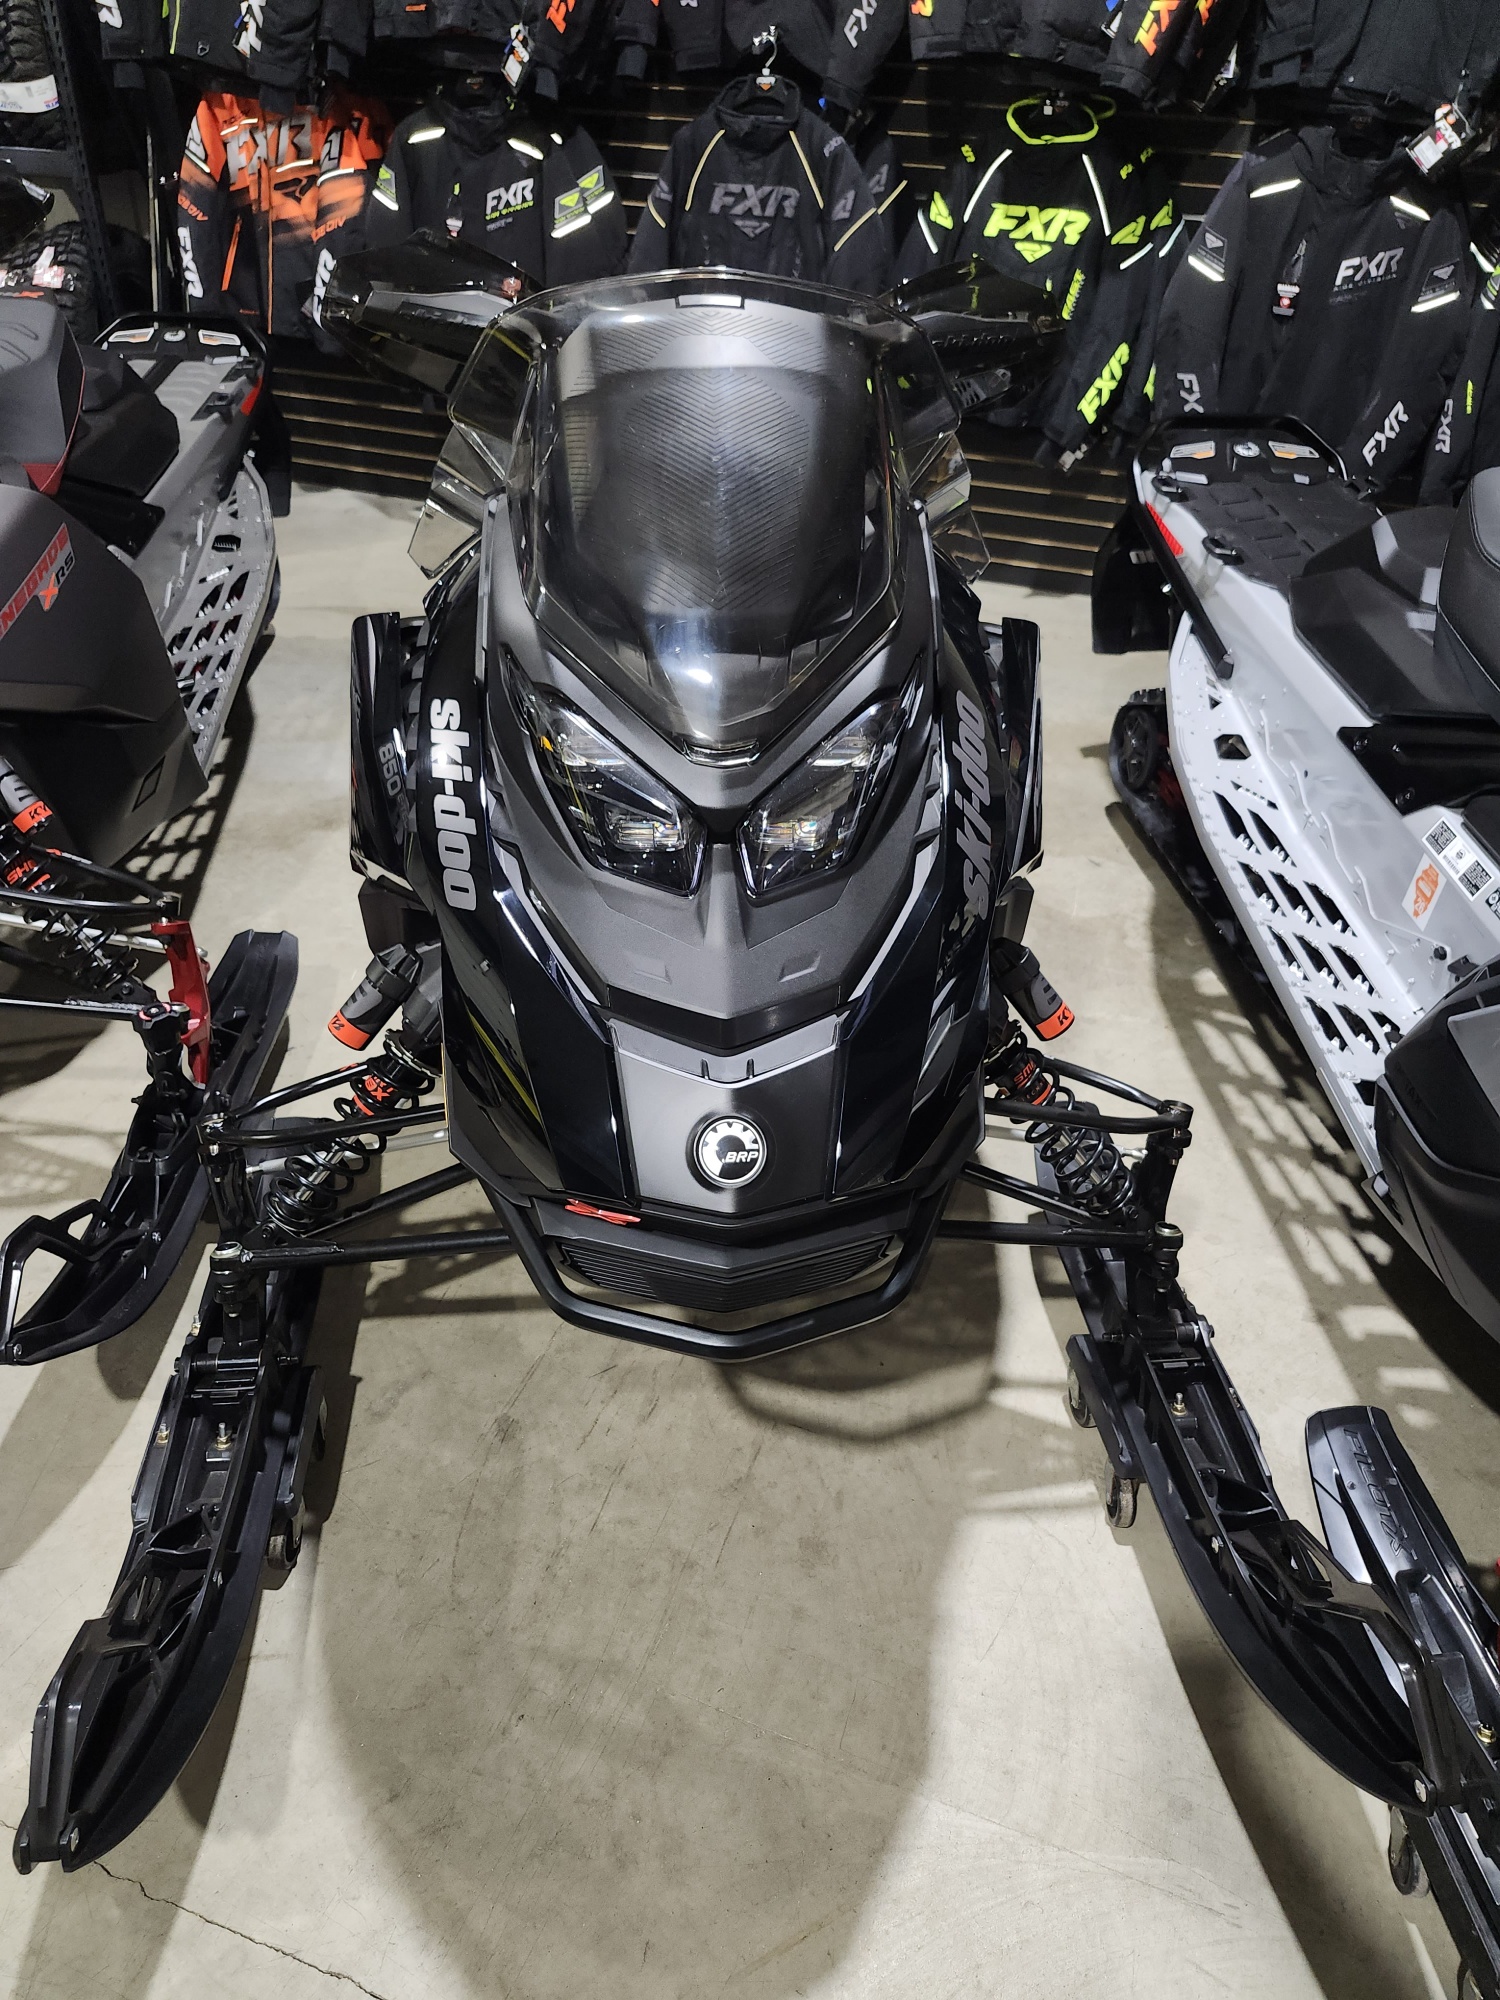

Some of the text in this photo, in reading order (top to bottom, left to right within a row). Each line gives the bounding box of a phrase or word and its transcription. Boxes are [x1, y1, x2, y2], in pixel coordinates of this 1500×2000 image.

[486, 177, 535, 216] FXR
[708, 182, 800, 219] FXR
[984, 202, 1092, 246] FXR
[1334, 247, 1405, 286] FXR
[1077, 341, 1131, 426] FXR
[1362, 400, 1410, 468] FXR
[378, 741, 403, 797] 850
[430, 698, 478, 912] ski-doo
[951, 689, 992, 921] ski-doo
[725, 1150, 759, 1164] BRP
